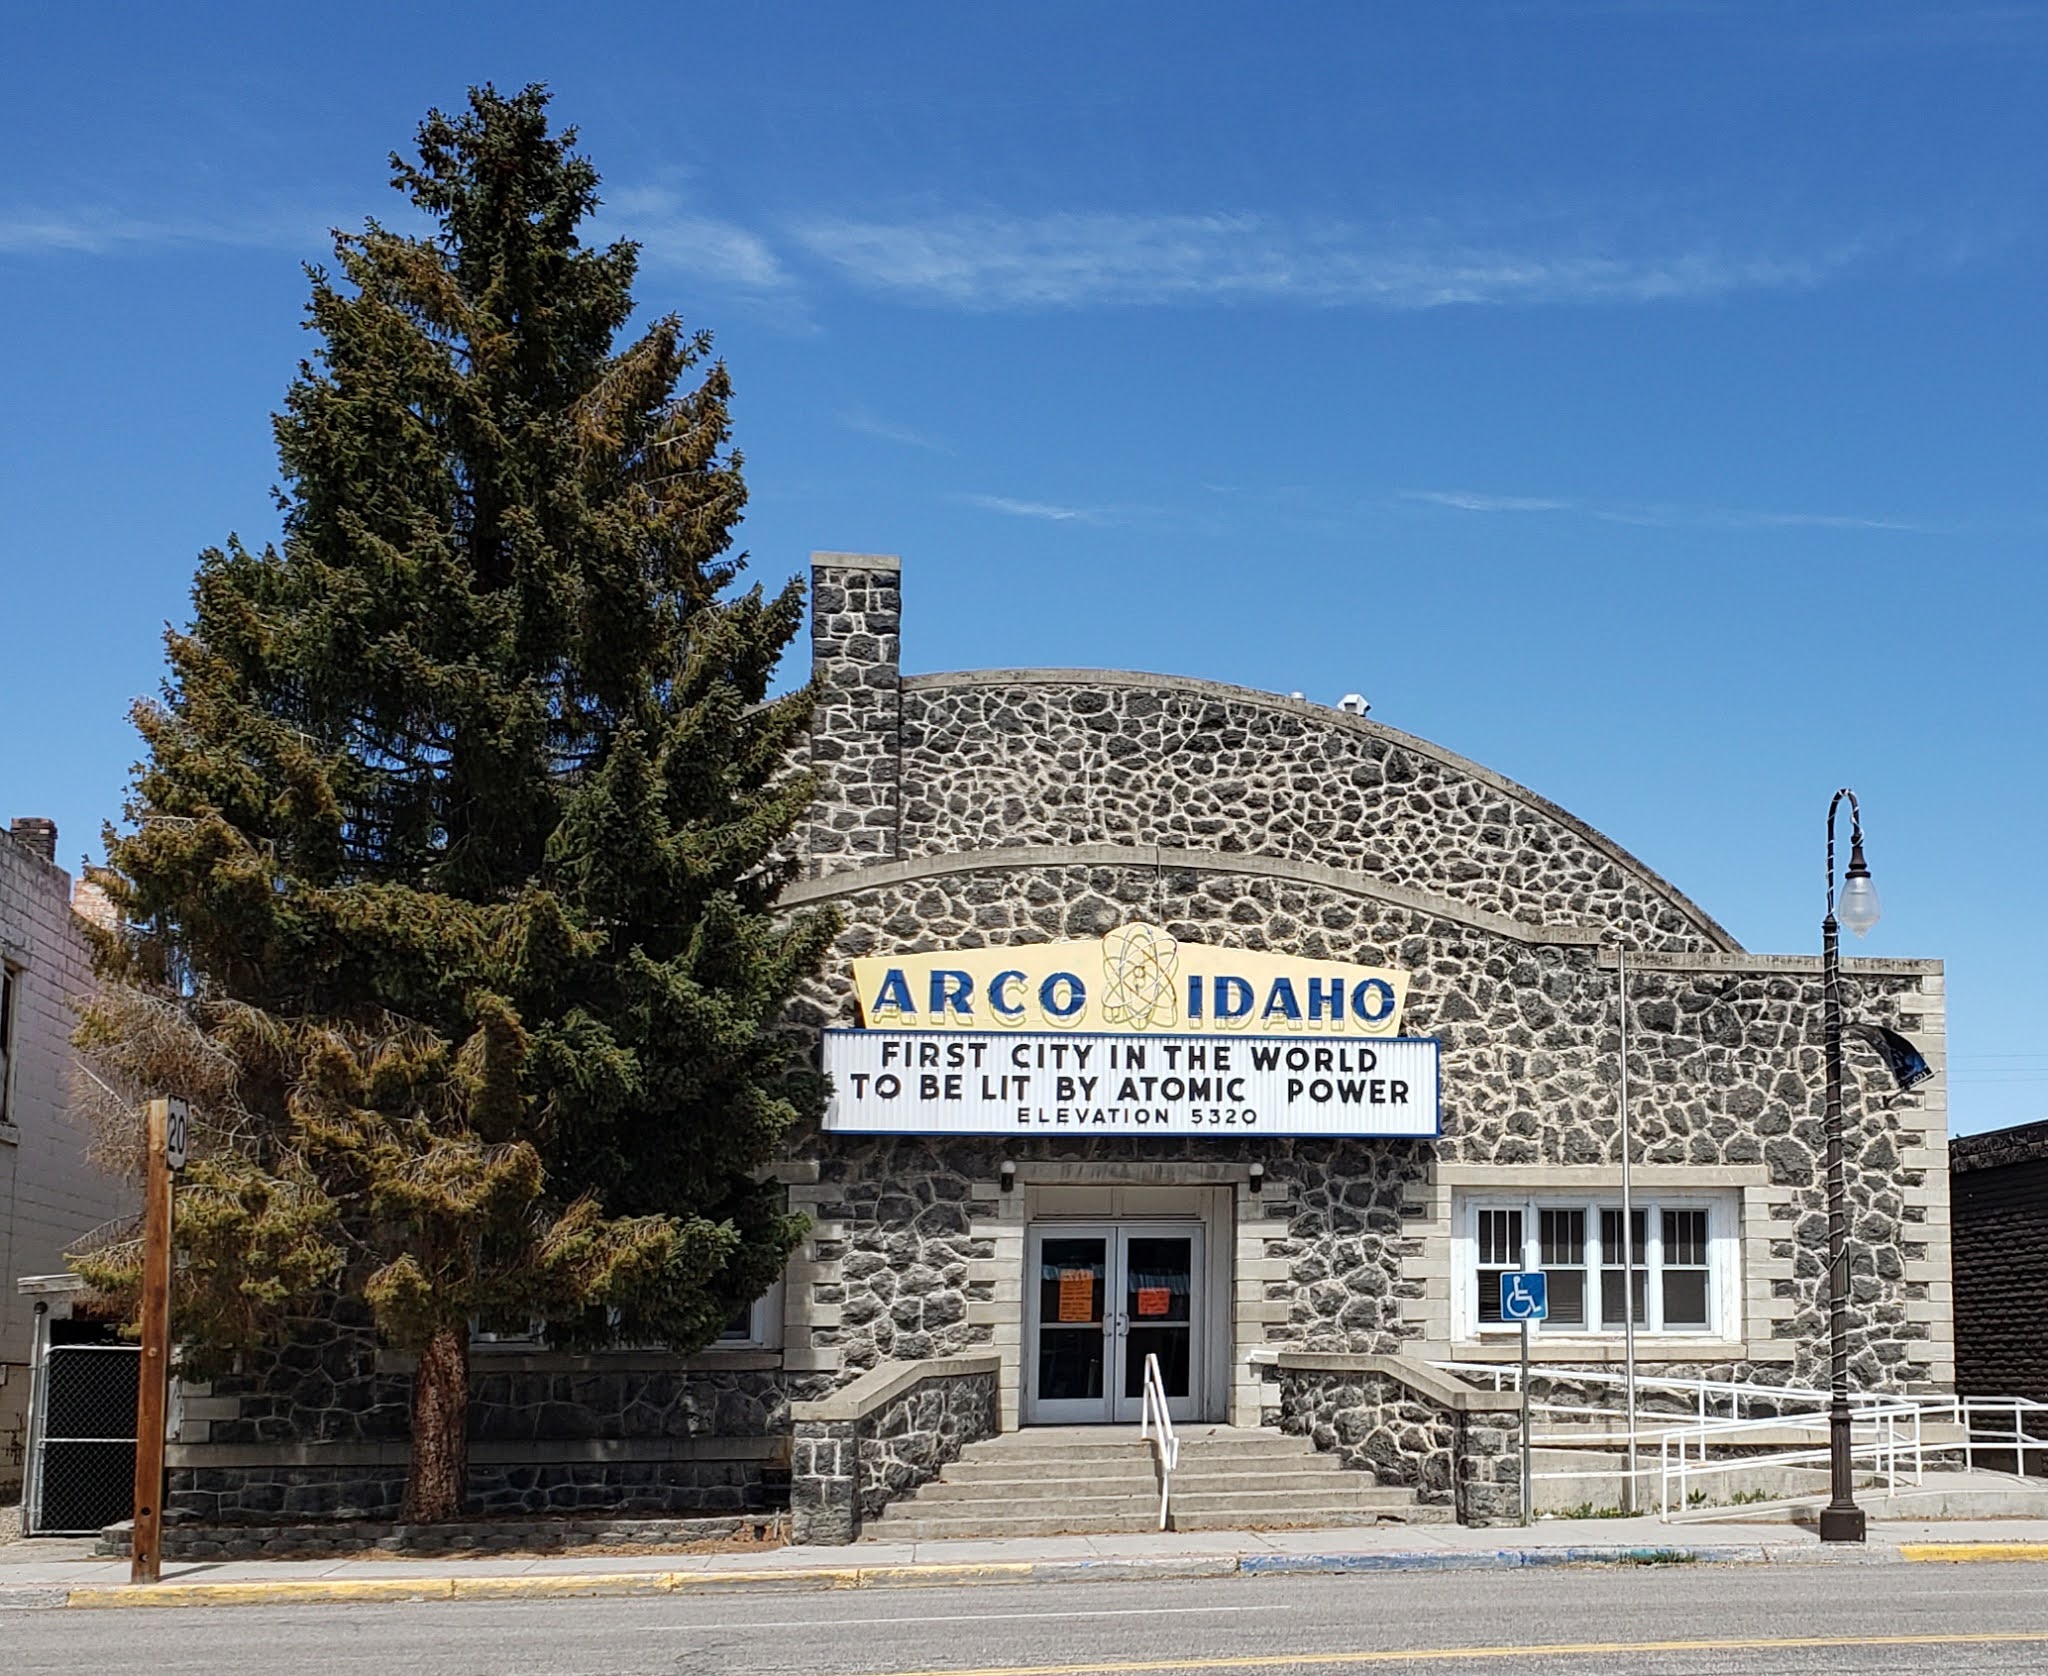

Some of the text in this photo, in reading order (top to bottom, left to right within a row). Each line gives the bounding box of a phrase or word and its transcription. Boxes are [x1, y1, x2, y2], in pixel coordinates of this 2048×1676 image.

[871, 968, 1396, 1022] ARCO IDAHO
[881, 1041, 1378, 1073] FIRST CITY IN THE WORLD
[850, 1073, 1410, 1104] TO BE LIT BY ATOMIC POWER
[1017, 1106, 1258, 1125] ELEVATION 5320
[167, 1112, 186, 1155] 20
